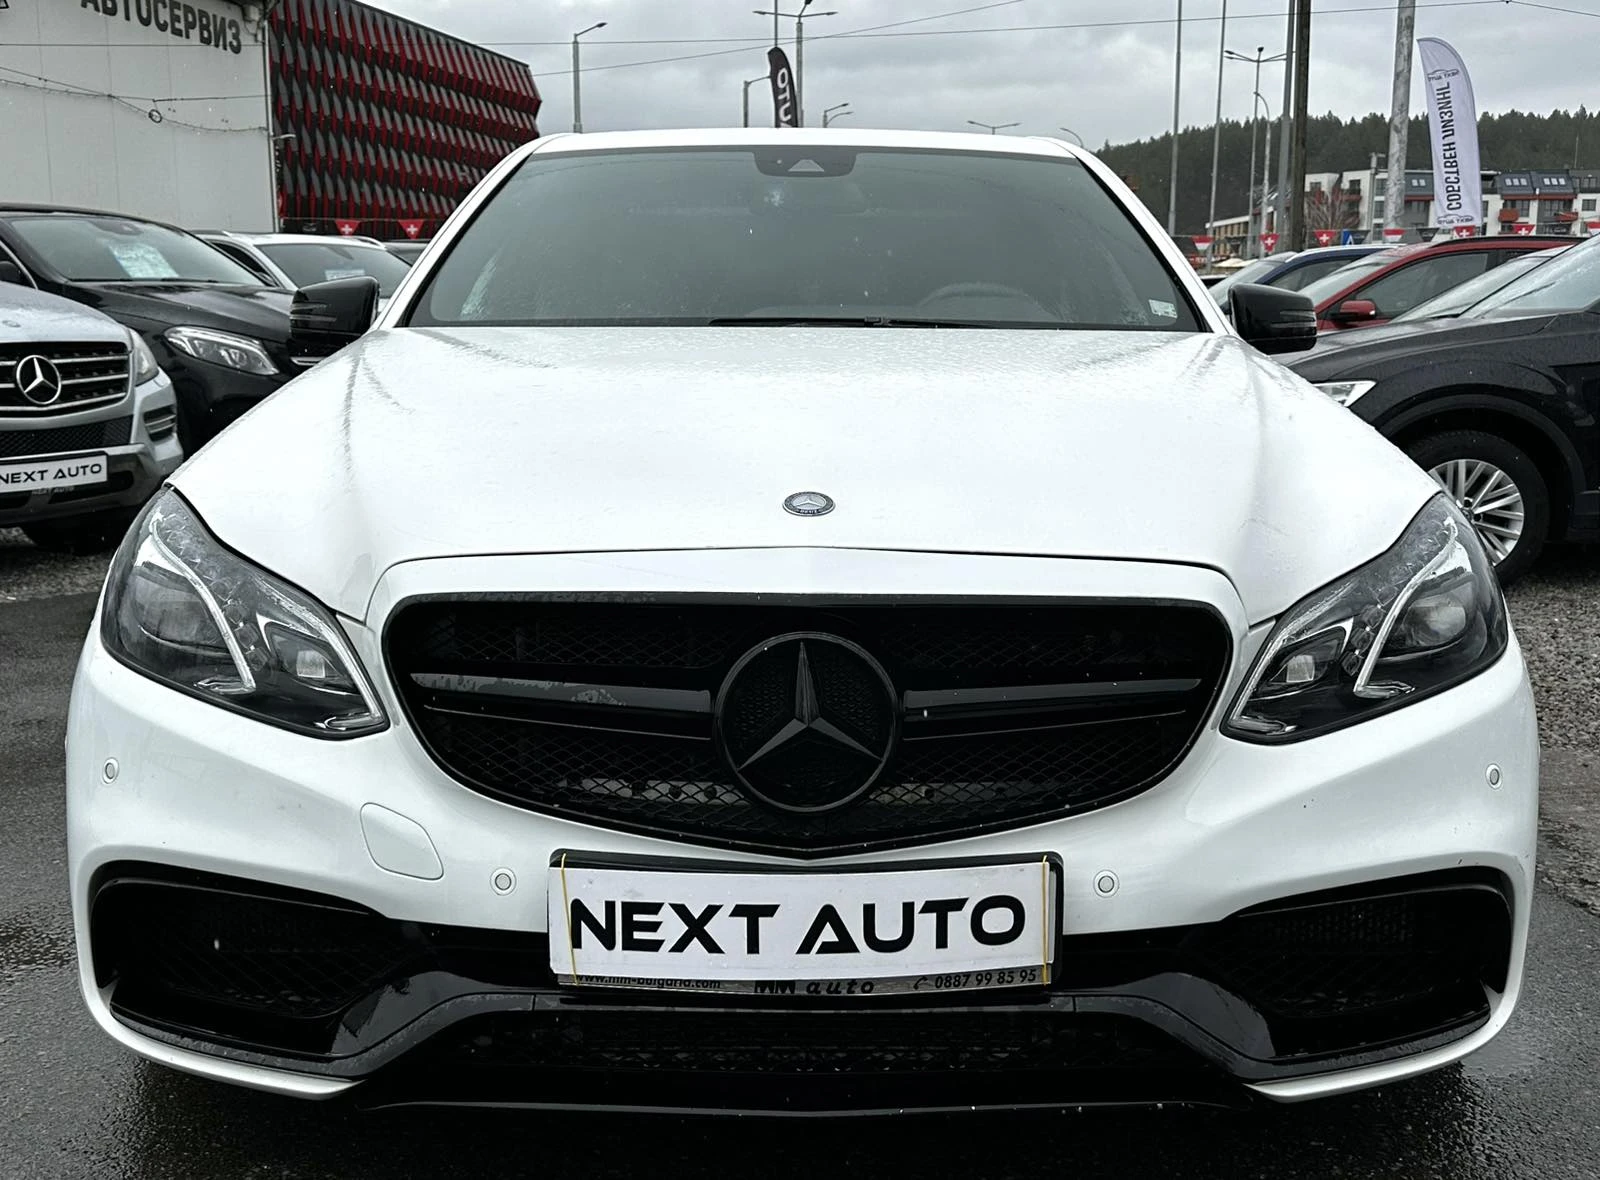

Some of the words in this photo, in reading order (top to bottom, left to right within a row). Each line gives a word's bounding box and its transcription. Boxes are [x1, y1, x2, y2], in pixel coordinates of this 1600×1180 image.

[0, 469, 48, 484] NEXT
[53, 463, 102, 480] AUTO
[570, 897, 780, 955] NEXT
[795, 894, 1026, 955] AUTO
[806, 979, 875, 995] auto
[934, 973, 971, 989] 0887
[976, 972, 993, 985] 99
[997, 970, 1015, 984] 85
[1019, 969, 1037, 983] 95
